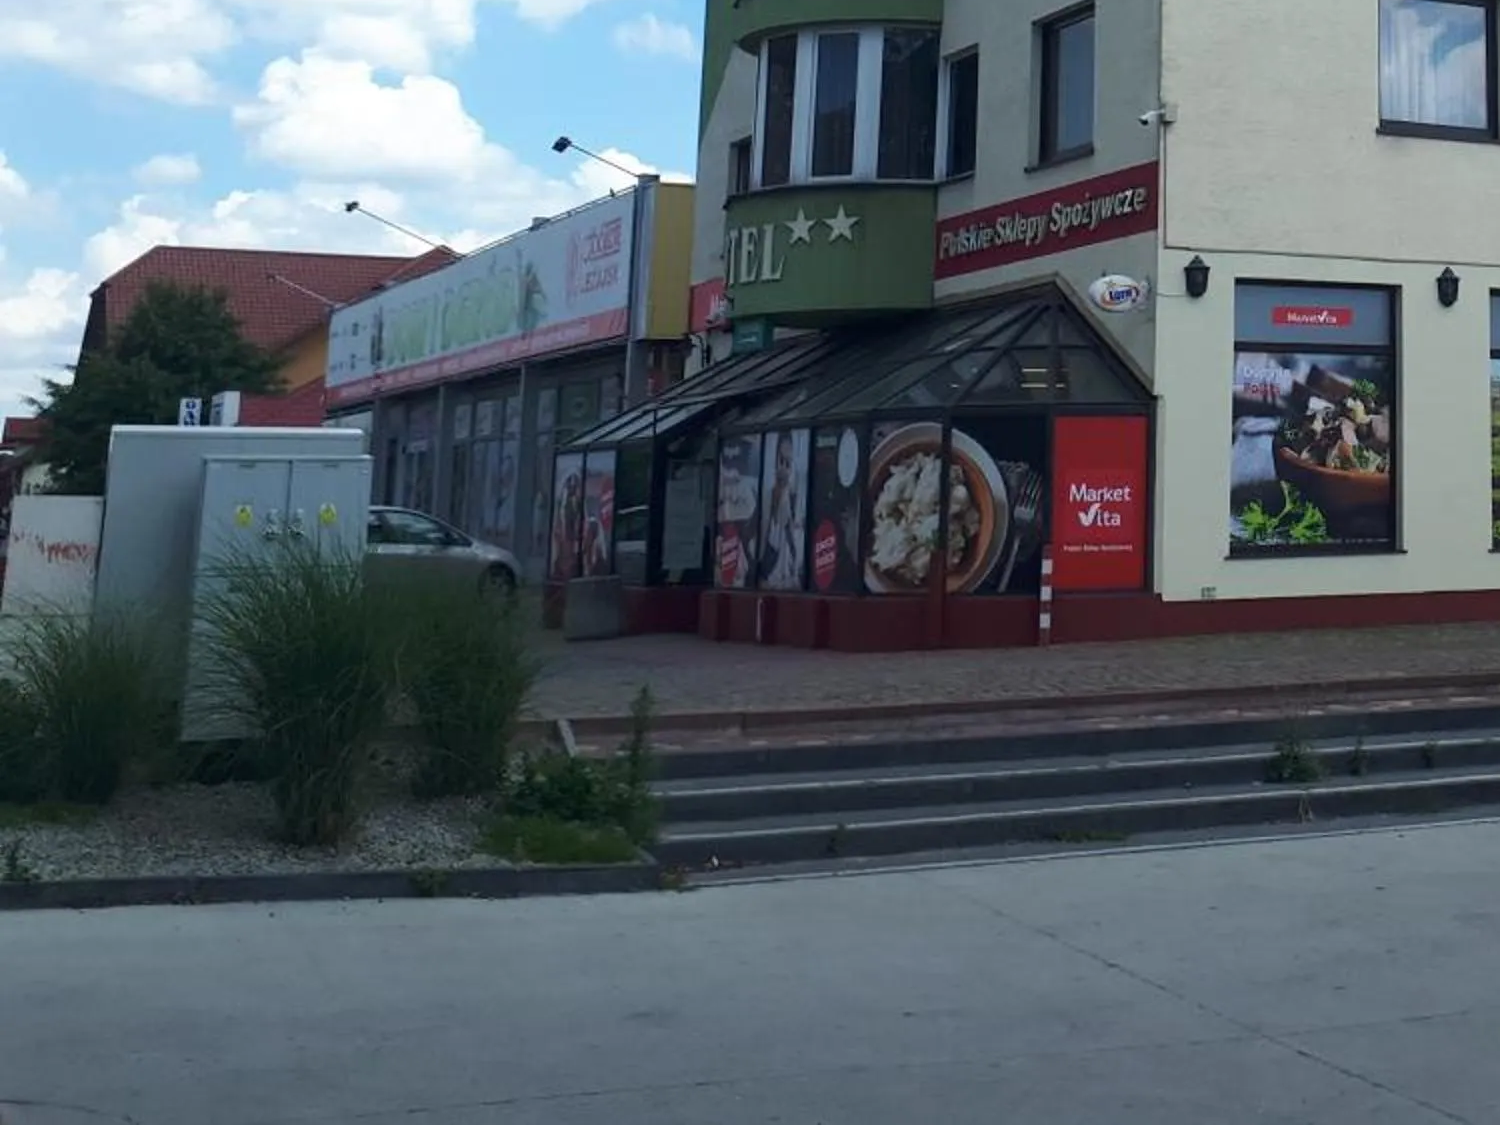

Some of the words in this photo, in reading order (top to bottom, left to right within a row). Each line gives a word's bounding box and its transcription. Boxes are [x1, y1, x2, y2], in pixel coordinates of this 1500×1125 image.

[939, 220, 993, 261] Polskie
[994, 212, 1048, 247] Sklepy
[1049, 186, 1148, 237] Spożywcze
[1069, 482, 1132, 503] Market
[1078, 502, 1121, 528] Vita
